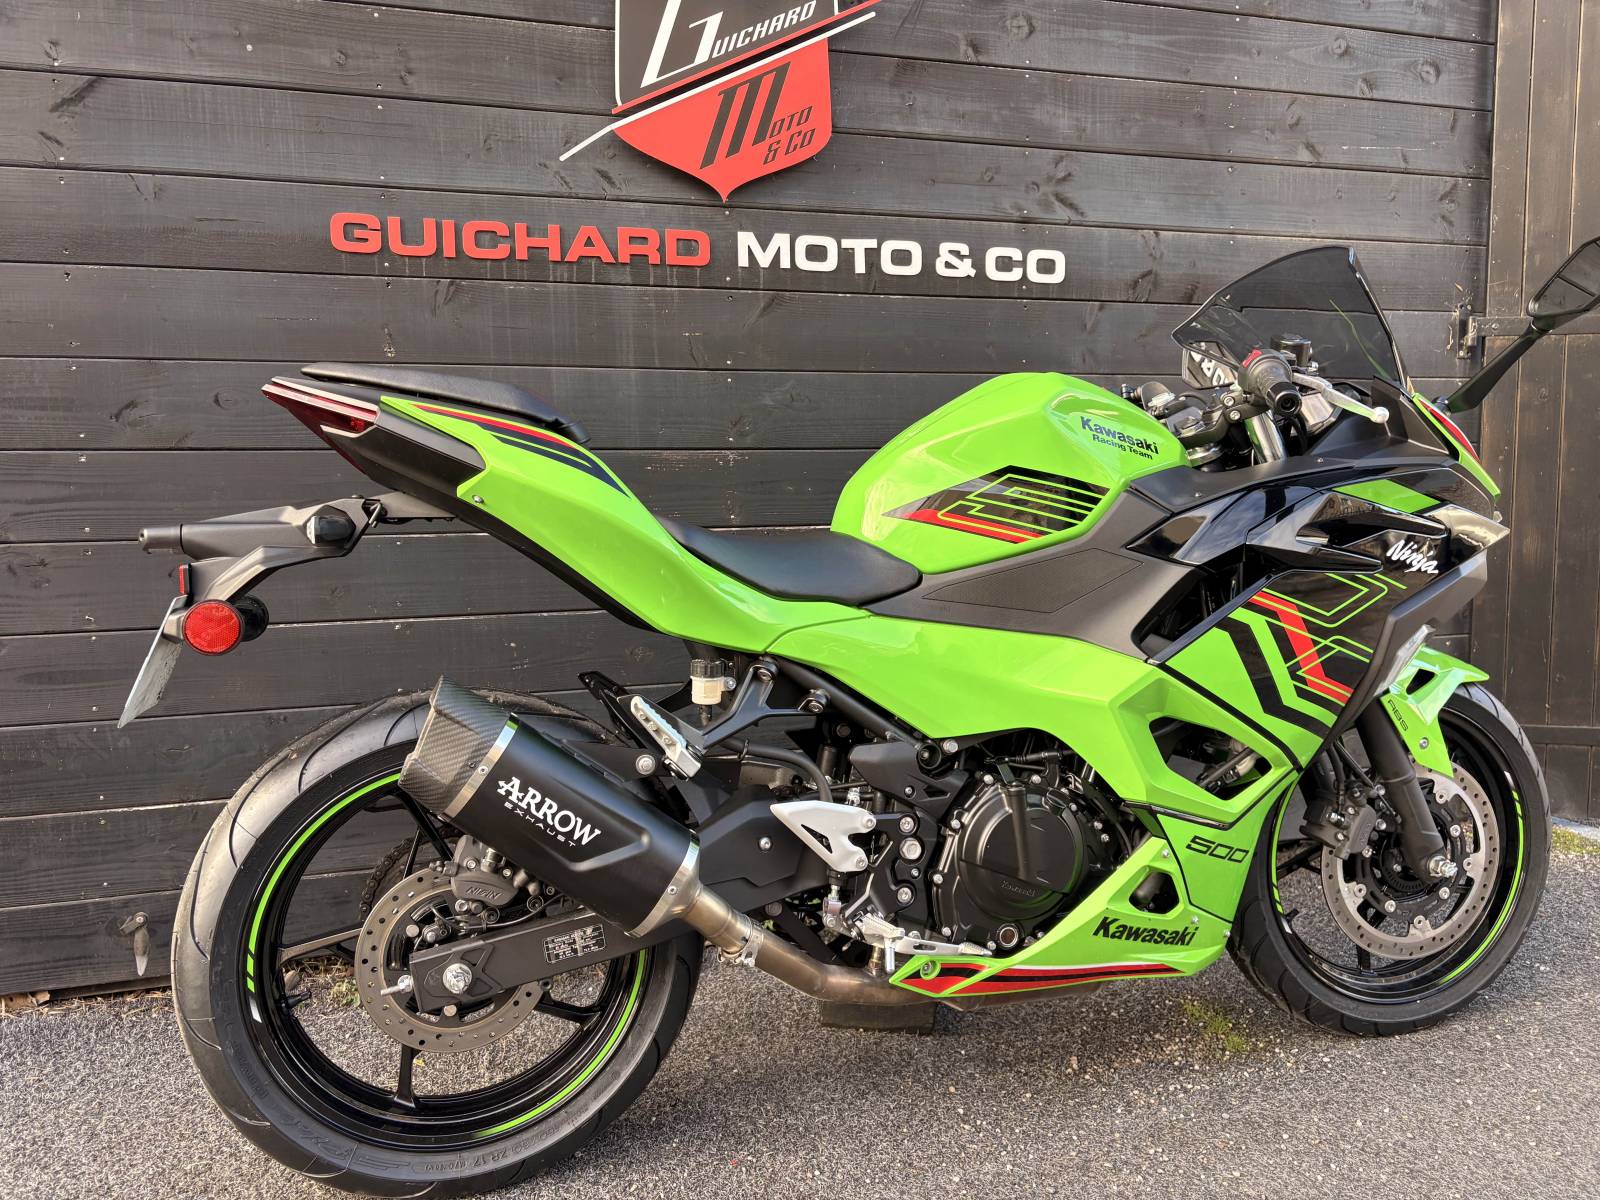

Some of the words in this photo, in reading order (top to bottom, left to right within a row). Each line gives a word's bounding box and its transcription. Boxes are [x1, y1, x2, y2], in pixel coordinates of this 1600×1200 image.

[763, 140, 779, 166] &
[330, 212, 711, 268] GUICHARD
[738, 231, 922, 277] MOTO
[936, 243, 976, 280] &
[984, 246, 1067, 285] CO
[1080, 415, 1159, 455] Kawasaki
[1092, 434, 1126, 453] Racing
[1126, 446, 1153, 461] Team
[1386, 539, 1439, 574] Ninja
[1388, 699, 1409, 732] ABS
[497, 776, 602, 846] ARROW
[504, 801, 576, 847] EXHAUST
[1186, 835, 1249, 863] 500
[1092, 916, 1199, 946] Kawasaki
